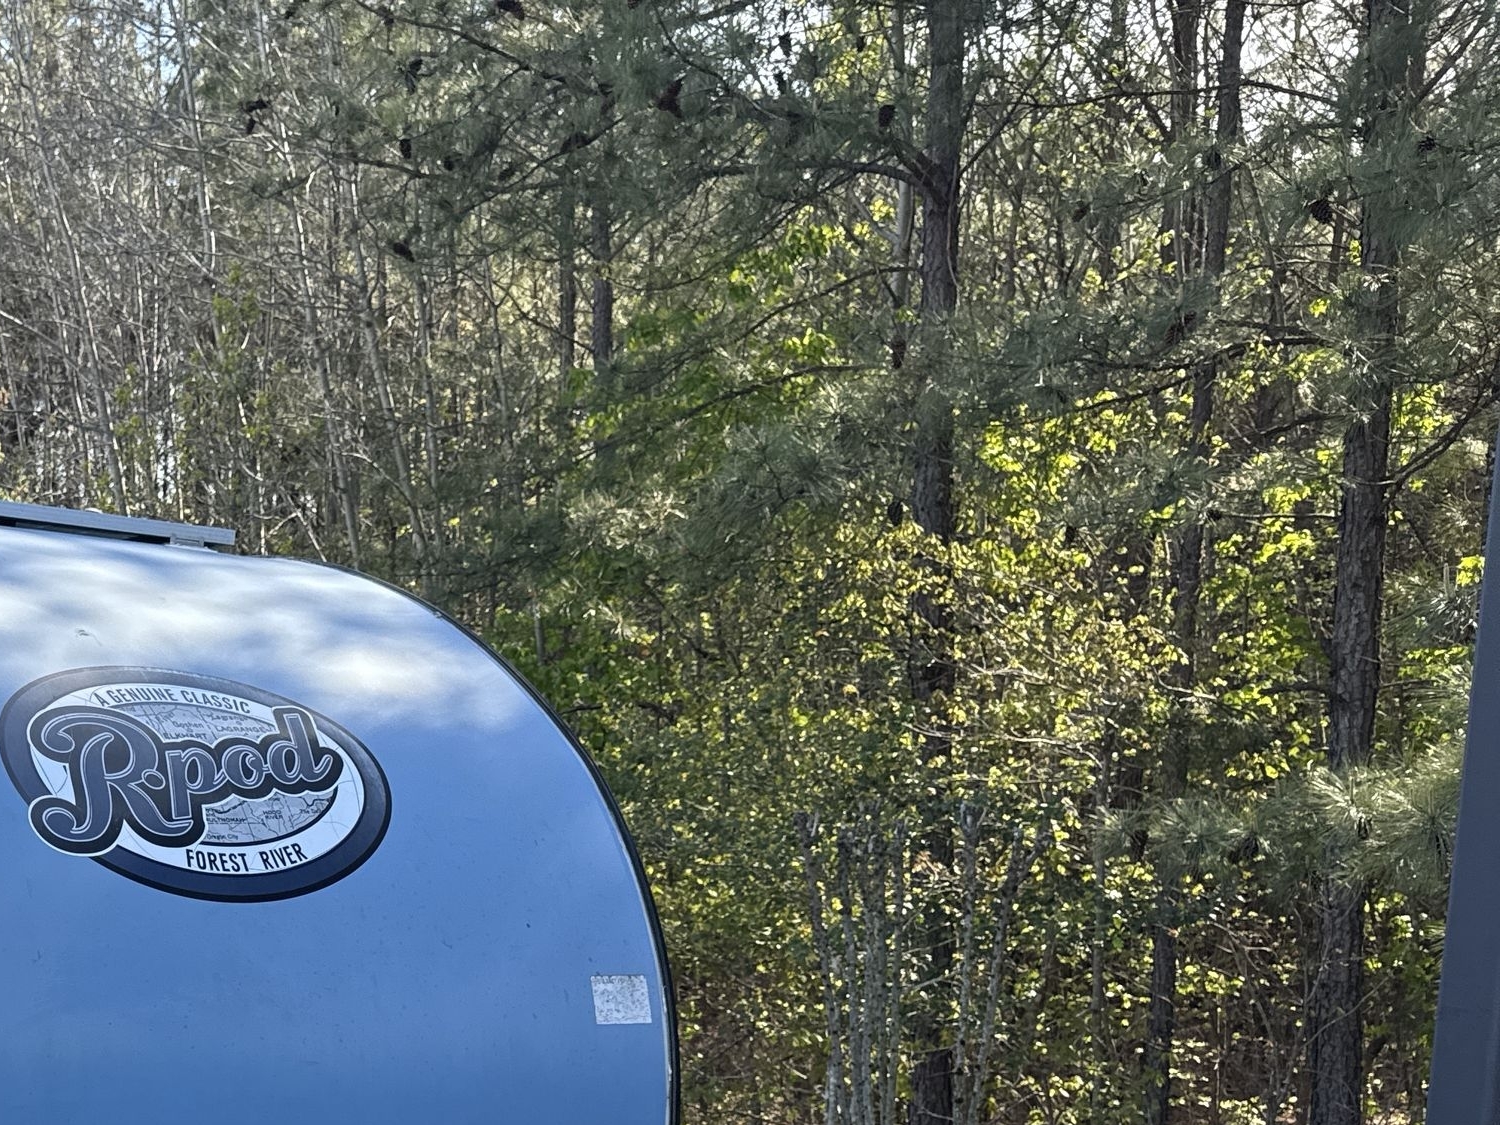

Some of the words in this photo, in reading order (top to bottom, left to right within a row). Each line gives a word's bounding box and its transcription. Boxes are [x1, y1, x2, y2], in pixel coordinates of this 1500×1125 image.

[93, 692, 110, 707] A
[106, 687, 179, 703] GENUINE
[180, 690, 250, 714] CLASSIC
[172, 720, 204, 730] Goshen
[162, 732, 208, 740] ELKHART
[185, 849, 249, 872] FOREST
[259, 842, 308, 870] RIVER
